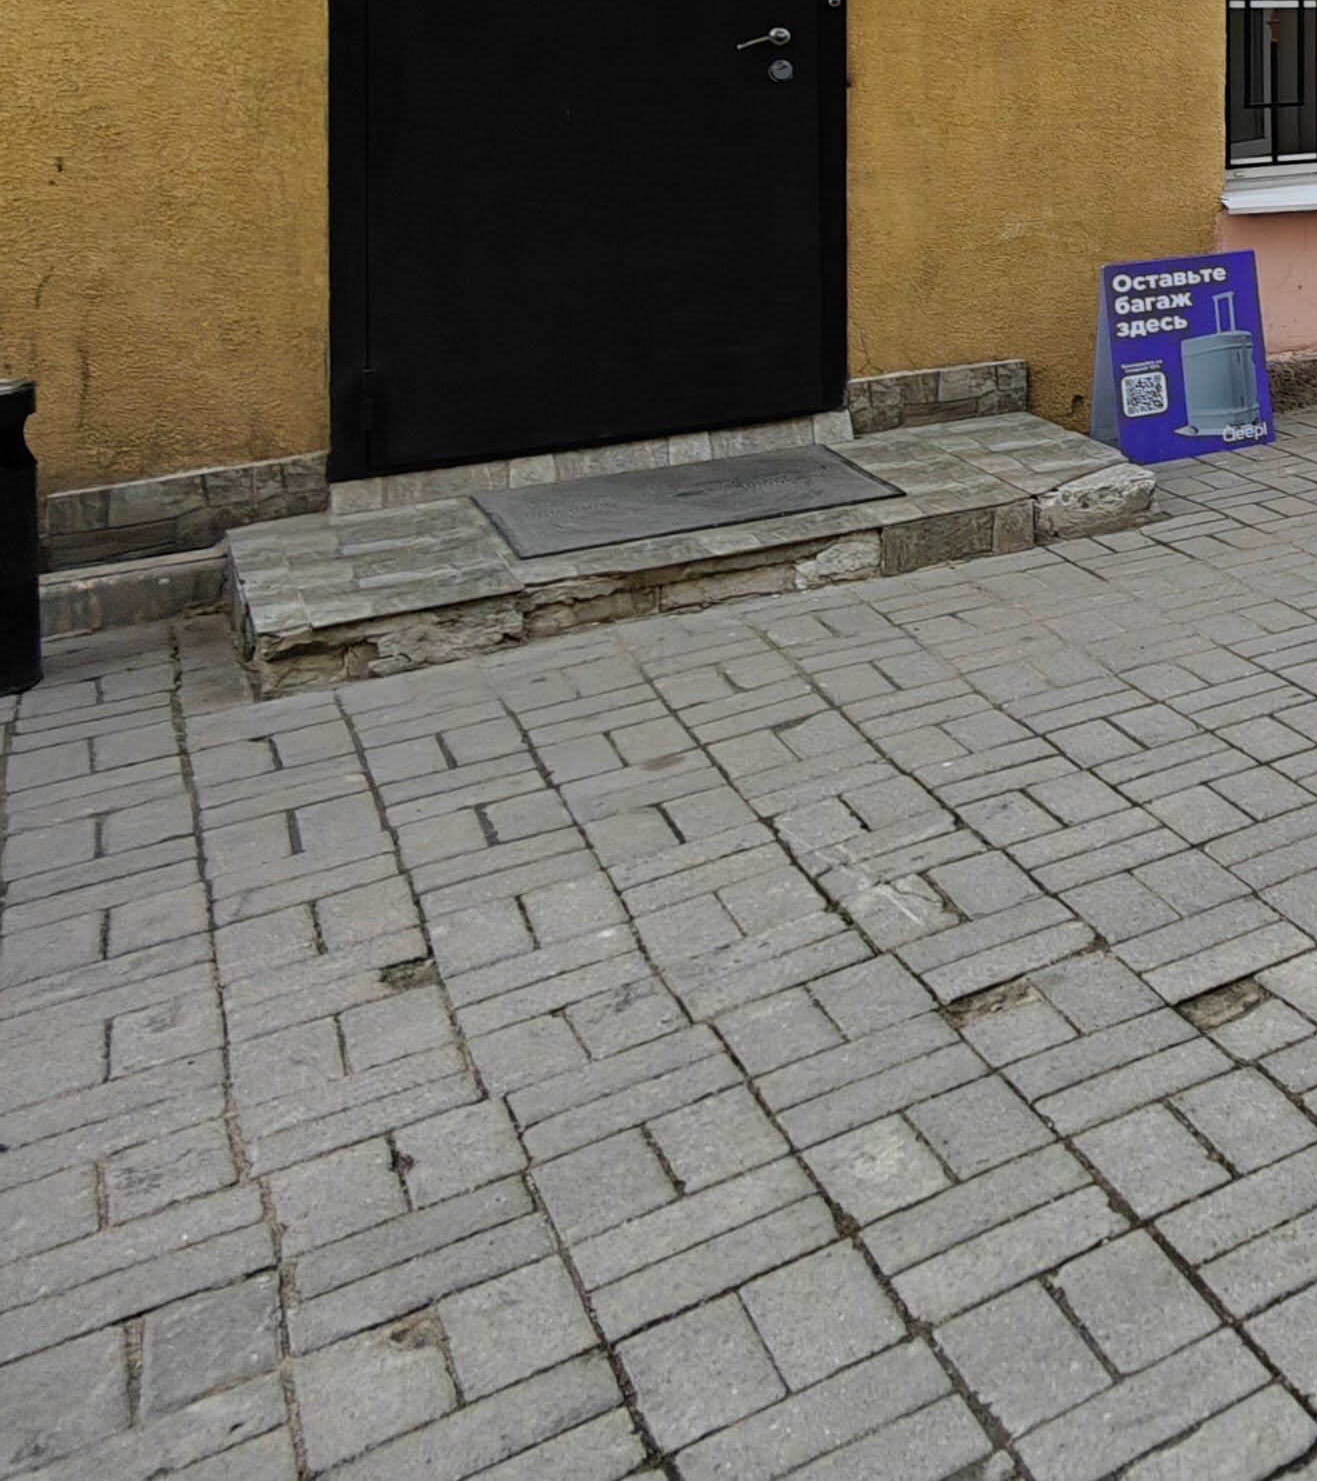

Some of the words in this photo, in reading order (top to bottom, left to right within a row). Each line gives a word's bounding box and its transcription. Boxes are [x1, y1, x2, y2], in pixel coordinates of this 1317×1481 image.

[1112, 267, 1227, 293] Оставьте
[1114, 292, 1193, 315] багаж
[1116, 315, 1188, 338] здесь
